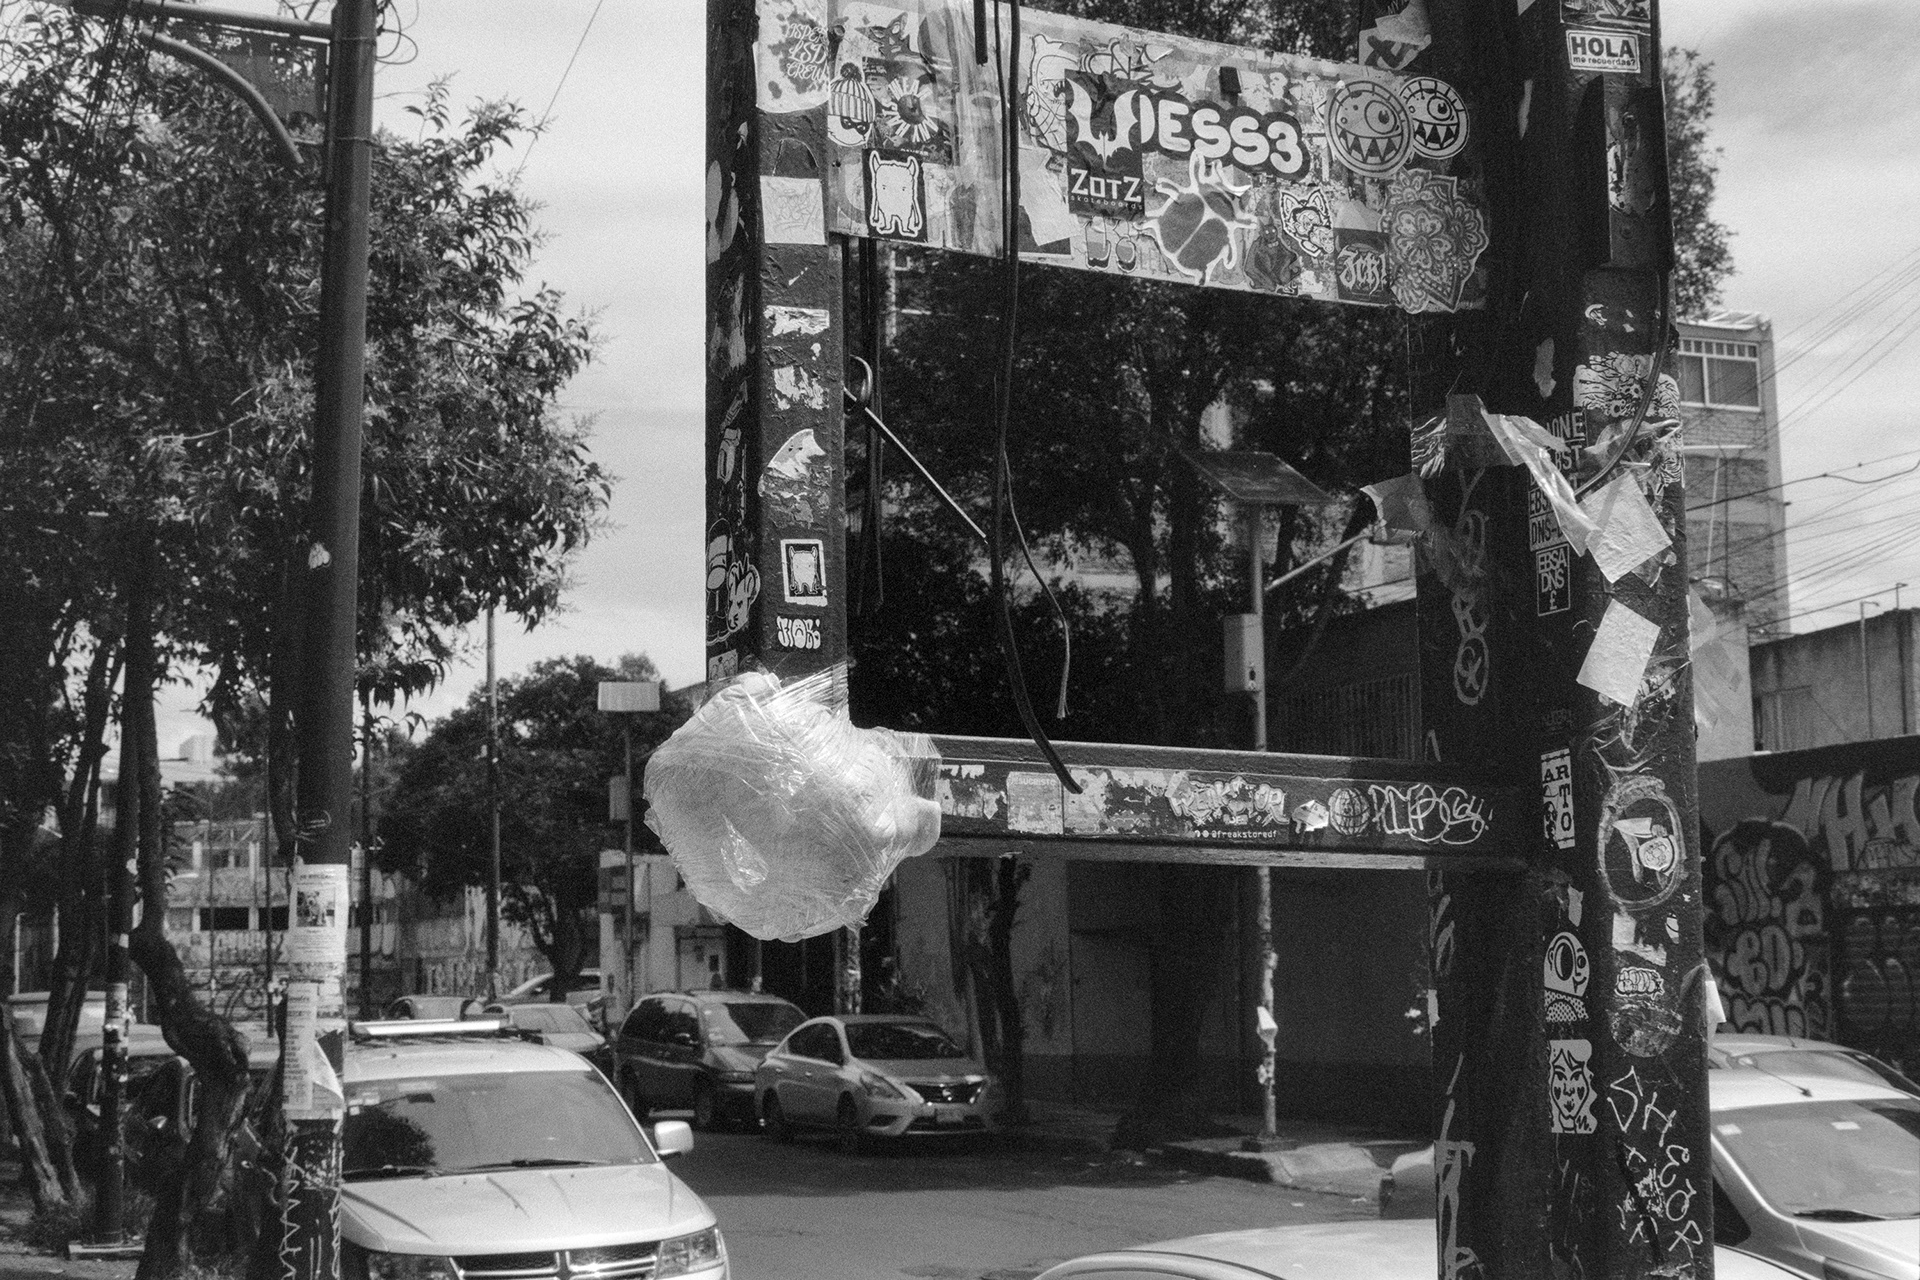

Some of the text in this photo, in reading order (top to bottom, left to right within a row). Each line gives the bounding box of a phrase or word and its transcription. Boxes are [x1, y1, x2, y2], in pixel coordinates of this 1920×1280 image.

[1571, 36, 1635, 58] HOLA
[1588, 57, 1636, 66] recuerdas?
[1070, 168, 1142, 203] ZOTZ
[1070, 195, 1143, 210] skateboards
